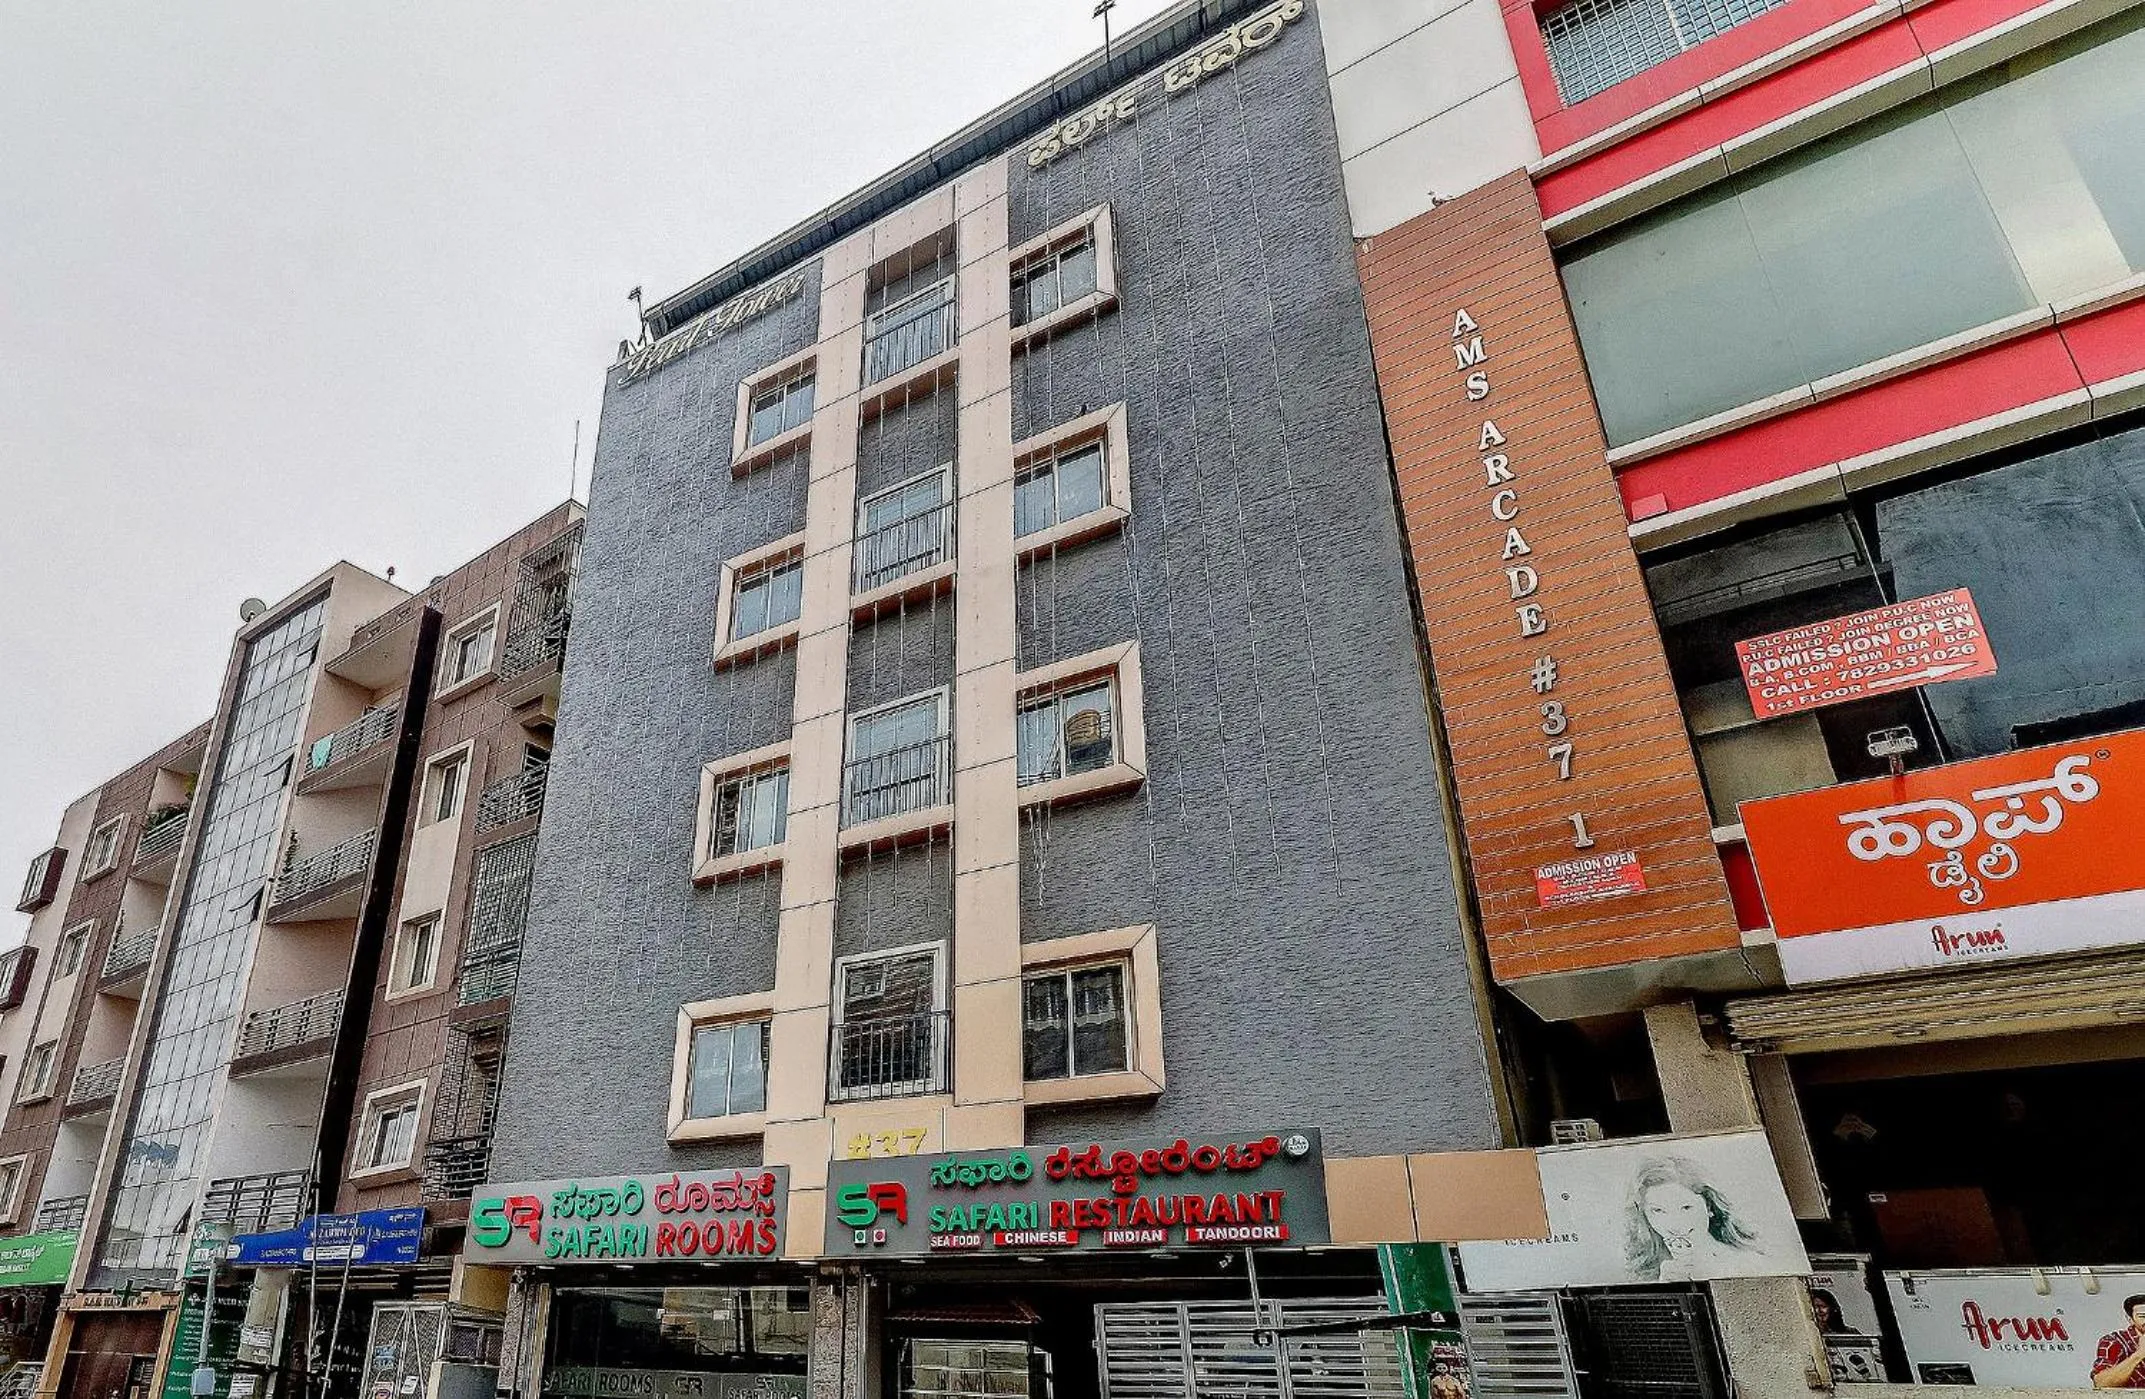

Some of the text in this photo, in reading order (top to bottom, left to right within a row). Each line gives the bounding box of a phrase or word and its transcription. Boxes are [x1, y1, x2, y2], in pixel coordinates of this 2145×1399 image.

[1452, 307, 1490, 401] AMS
[1477, 419, 1548, 638] ARCADE
[1568, 811, 1595, 850] 1
[1742, 649, 1775, 663] P.U.C
[1778, 637, 1823, 655] FAILED
[1838, 626, 1871, 640] JOIN
[1874, 612, 1931, 632] DEGREE
[1935, 602, 1969, 618] NOW
[1748, 636, 1781, 651] SSLC
[1785, 624, 1831, 642] FAILED
[1847, 613, 1878, 628] JOIN
[1882, 603, 1917, 619] P.U.C
[1920, 594, 1955, 609] NOW
[1748, 613, 1976, 677] ADMISSION OPEN
[1783, 661, 1834, 680] B.COM
[1847, 650, 1883, 666] BBM
[1895, 640, 1930, 655] BBA
[1944, 628, 1980, 643] BCA
[1761, 678, 1818, 699] CALL
[1836, 642, 1977, 681] 7829331026
[1798, 683, 1864, 705] FLOOR
[1538, 850, 1637, 879] ADMISSION OPEN
[1931, 924, 2006, 956] Arun
[847, 1127, 928, 1160] #37
[930, 1150, 1034, 1188] ಸಫಾರಿ
[550, 1179, 644, 1221] ಸಫಾರಿ
[929, 1190, 1287, 1233] SAFARI RESTAURANT
[545, 1218, 777, 1259] SAFARI ROOMS
[930, 1234, 981, 1248] SEA FOOD
[1004, 1231, 1068, 1245] CHINESE
[1107, 1229, 1163, 1244] INDIAN
[1195, 1226, 1281, 1241] TANDOORI
[1961, 1300, 2070, 1350] Arun
[598, 1373, 653, 1394] ROOMS
